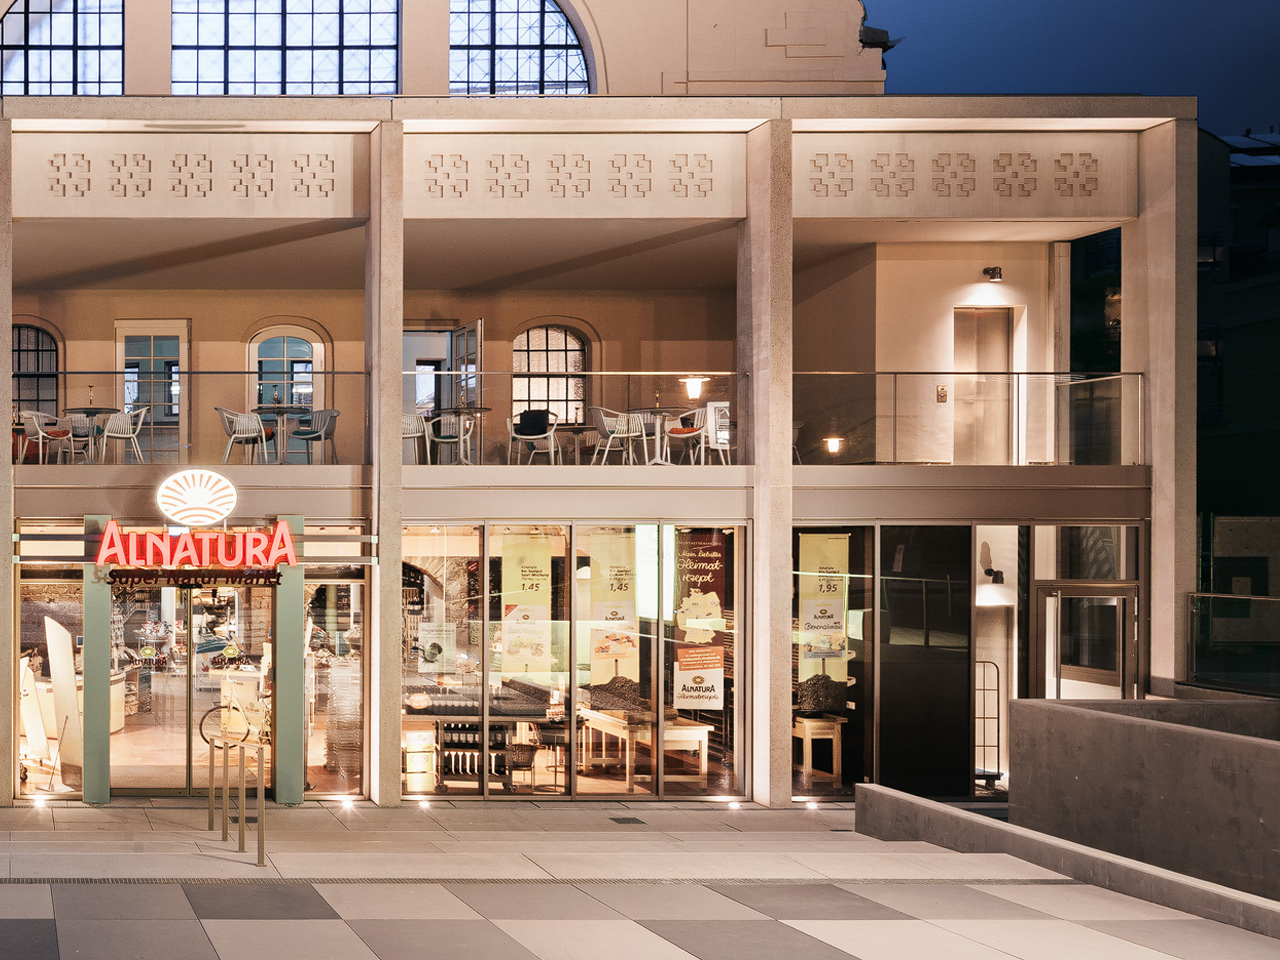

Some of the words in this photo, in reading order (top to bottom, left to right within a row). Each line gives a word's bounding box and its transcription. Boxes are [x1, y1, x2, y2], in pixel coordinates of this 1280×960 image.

[96, 519, 298, 566] ALNATURA
[676, 558, 724, 570] Heimat-
[107, 569, 164, 588] Super
[166, 569, 218, 586] Natur
[225, 569, 283, 586] Markt
[521, 583, 540, 592] 1,45
[609, 583, 629, 592] 1,45
[818, 583, 838, 593] 1,95
[128, 656, 167, 666] ALNATURA
[681, 683, 716, 693] ALNATURA
